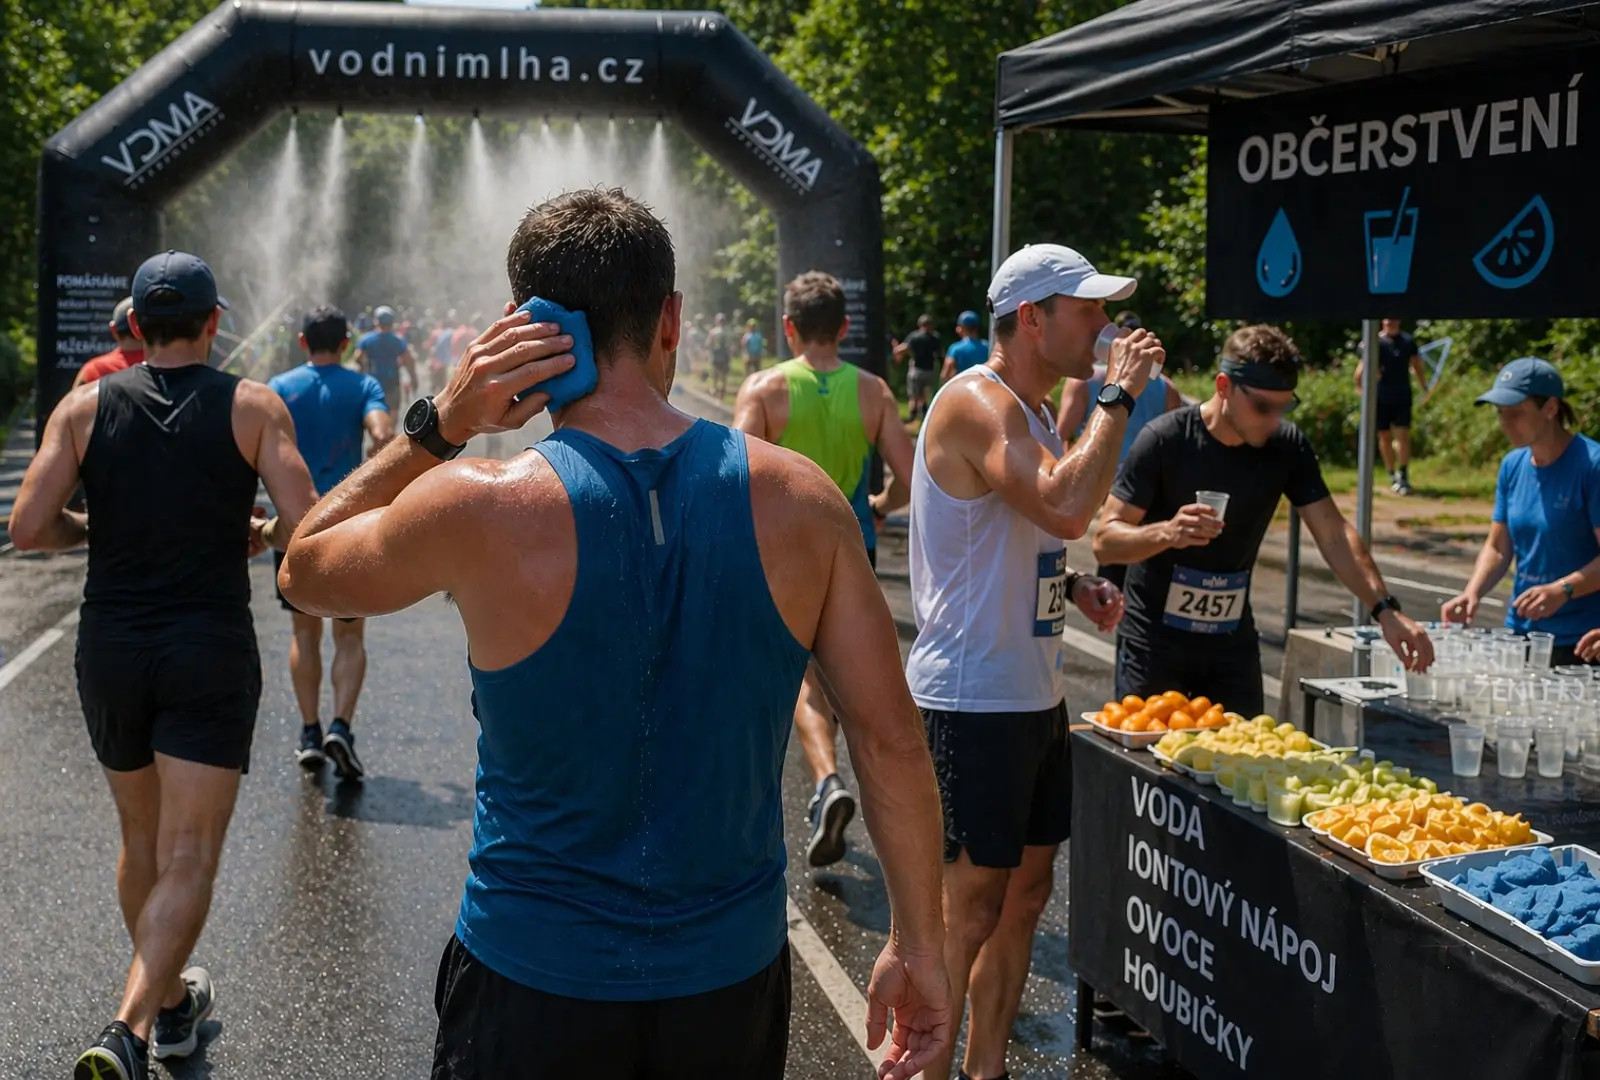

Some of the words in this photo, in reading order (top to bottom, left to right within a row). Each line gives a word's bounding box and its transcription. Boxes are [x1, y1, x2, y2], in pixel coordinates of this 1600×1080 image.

[308, 43, 645, 84] vodnimlha.cz
[100, 90, 215, 175] VDMA
[740, 97, 823, 188] VDMA
[1237, 73, 1583, 184] OBČERSTVENÍ
[1047, 581, 1066, 614] 23
[1178, 590, 1237, 617] 2457
[1131, 776, 1205, 850] VODA
[1126, 895, 1215, 982] OVOCE
[1127, 834, 1235, 927] IONTOVÝ
[1240, 899, 1337, 994] NÁPOJ
[1123, 947, 1253, 1071] HOUBIČKY
